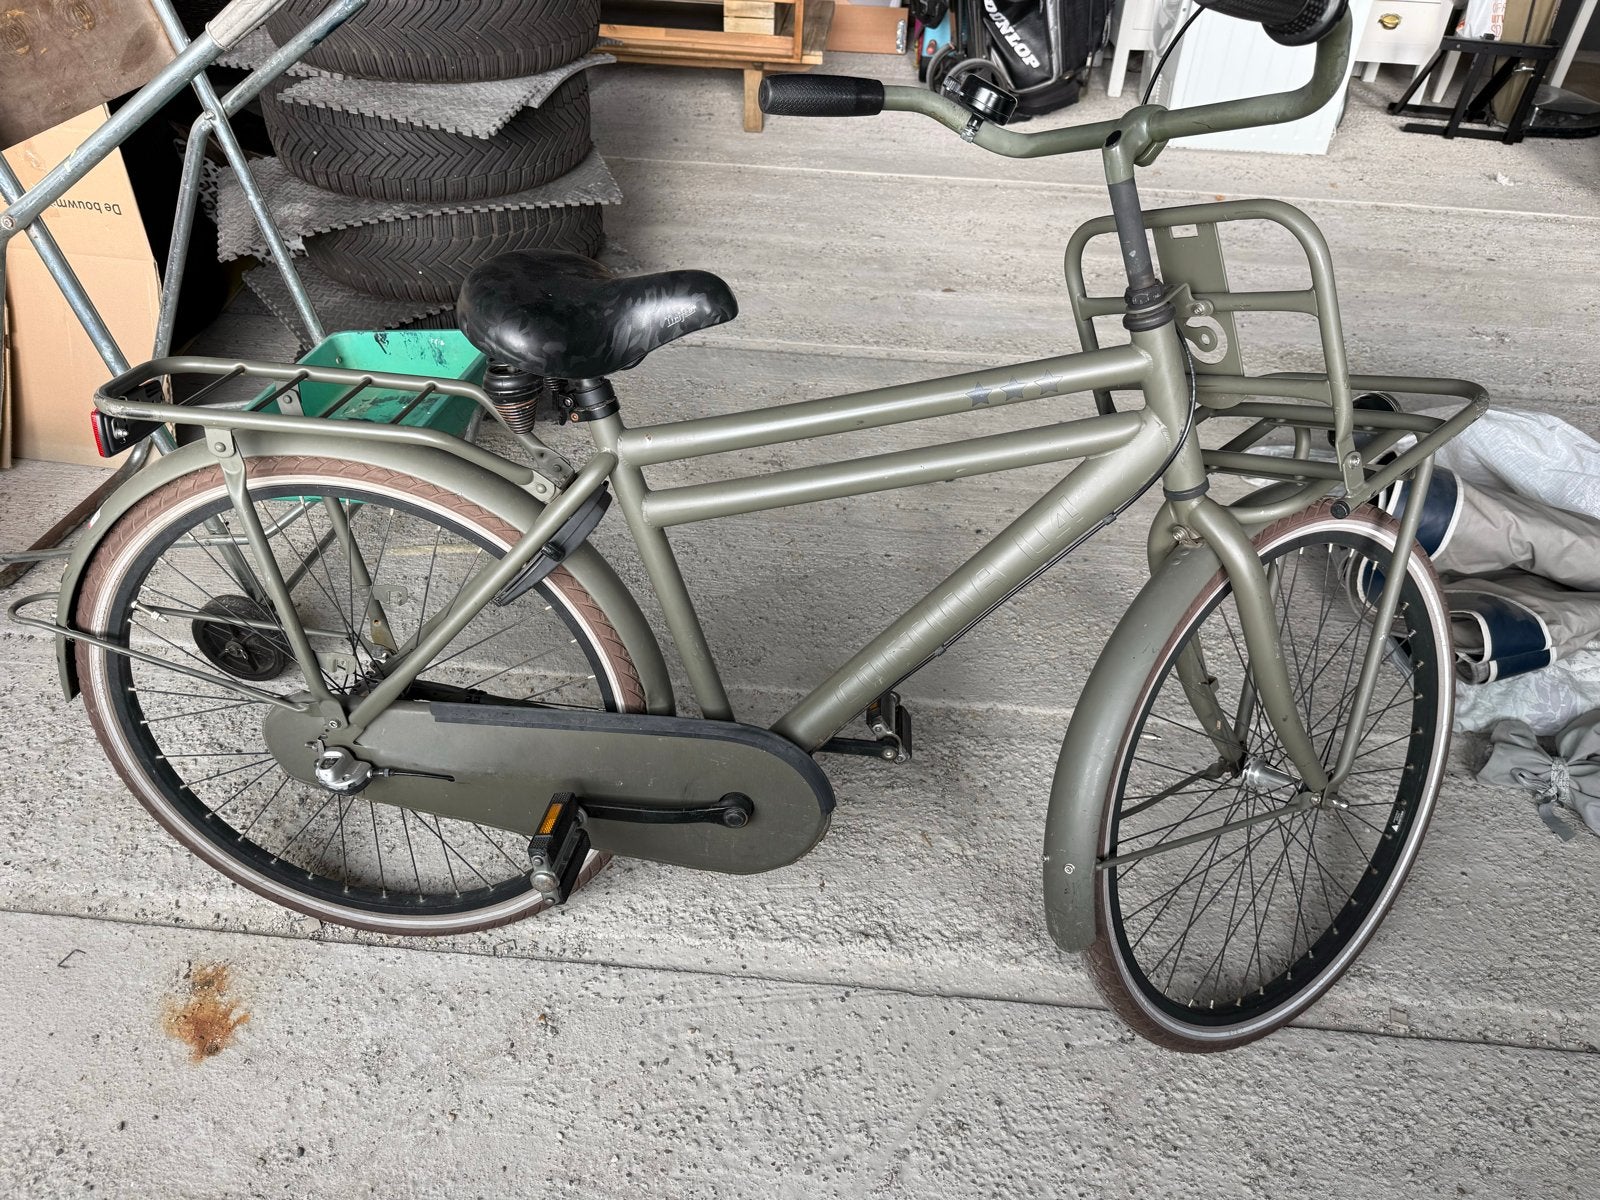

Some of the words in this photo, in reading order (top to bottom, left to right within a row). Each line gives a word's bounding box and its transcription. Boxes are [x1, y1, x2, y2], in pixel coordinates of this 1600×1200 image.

[983, 0, 1041, 69] DUNLOP
[50, 198, 103, 214] bouwm
[104, 203, 123, 216] De
[1009, 493, 1084, 562] U4
